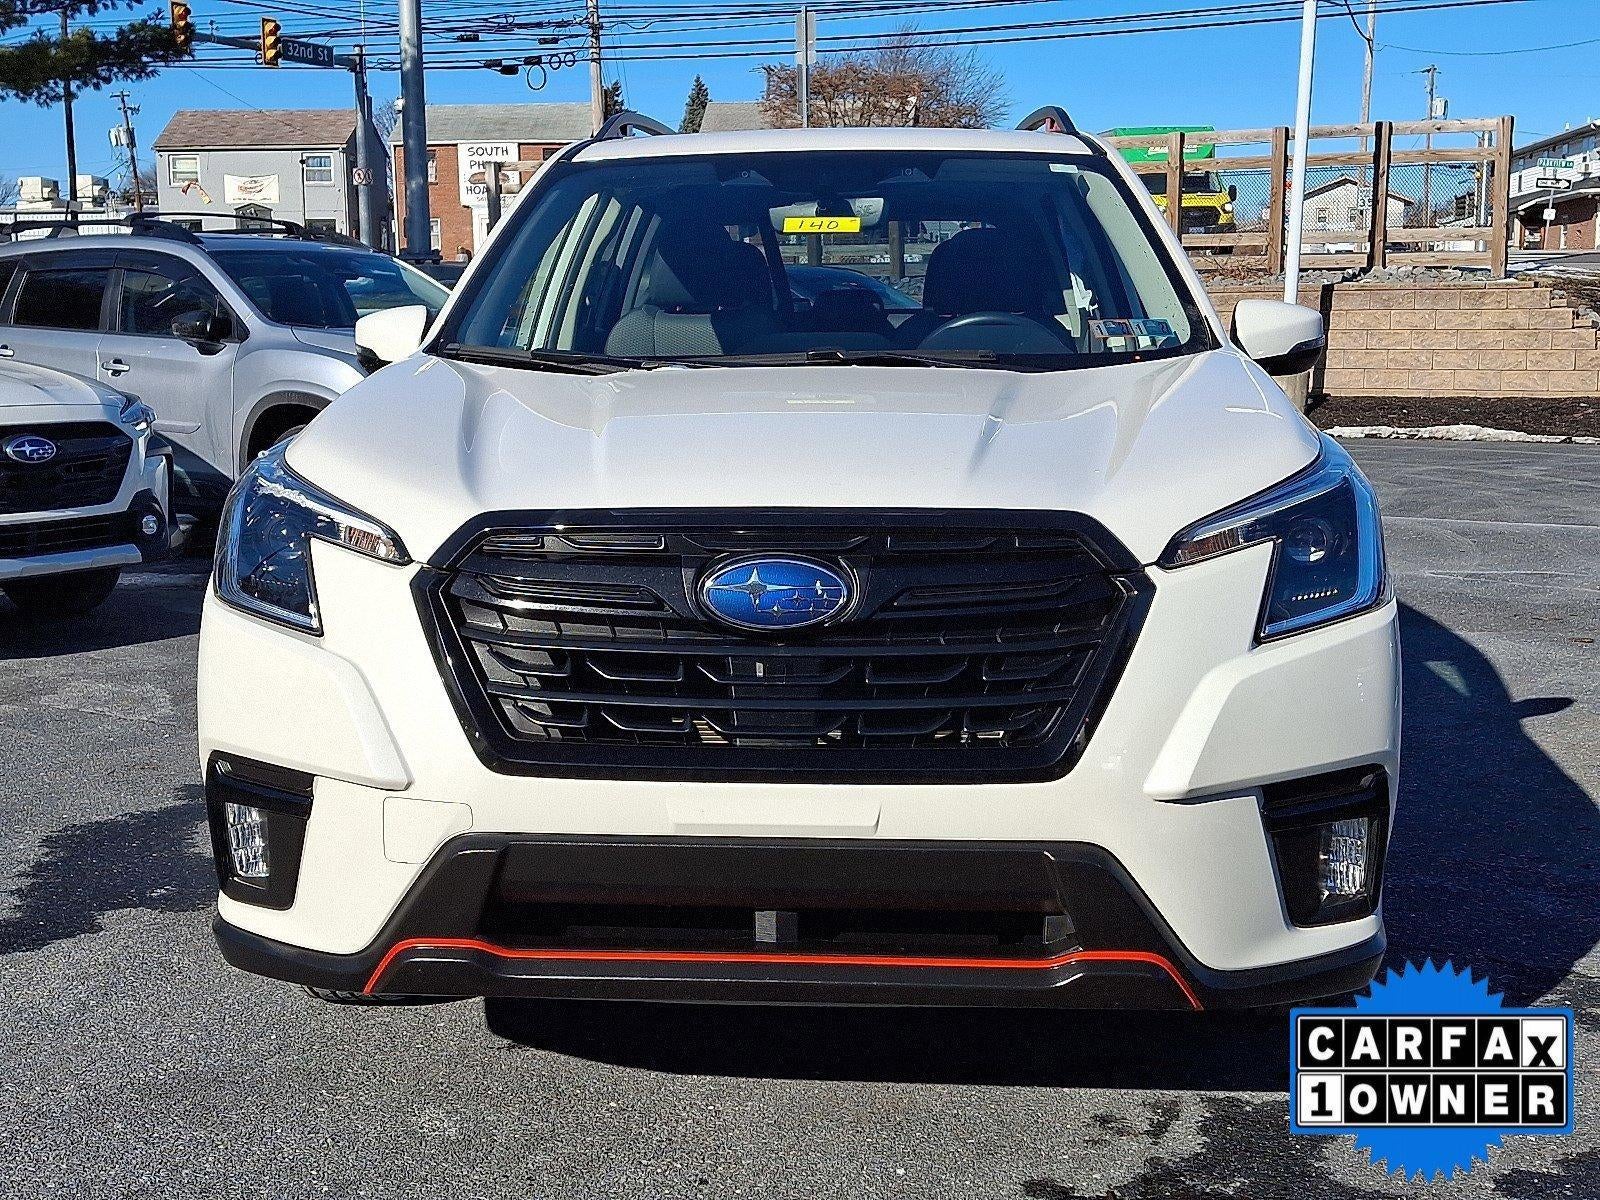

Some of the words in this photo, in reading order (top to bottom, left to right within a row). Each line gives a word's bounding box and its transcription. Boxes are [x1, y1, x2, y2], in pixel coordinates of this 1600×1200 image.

[287, 42, 313, 59] 32nd
[318, 47, 328, 61] St
[468, 146, 509, 156] SOUTH
[798, 220, 839, 230] 140
